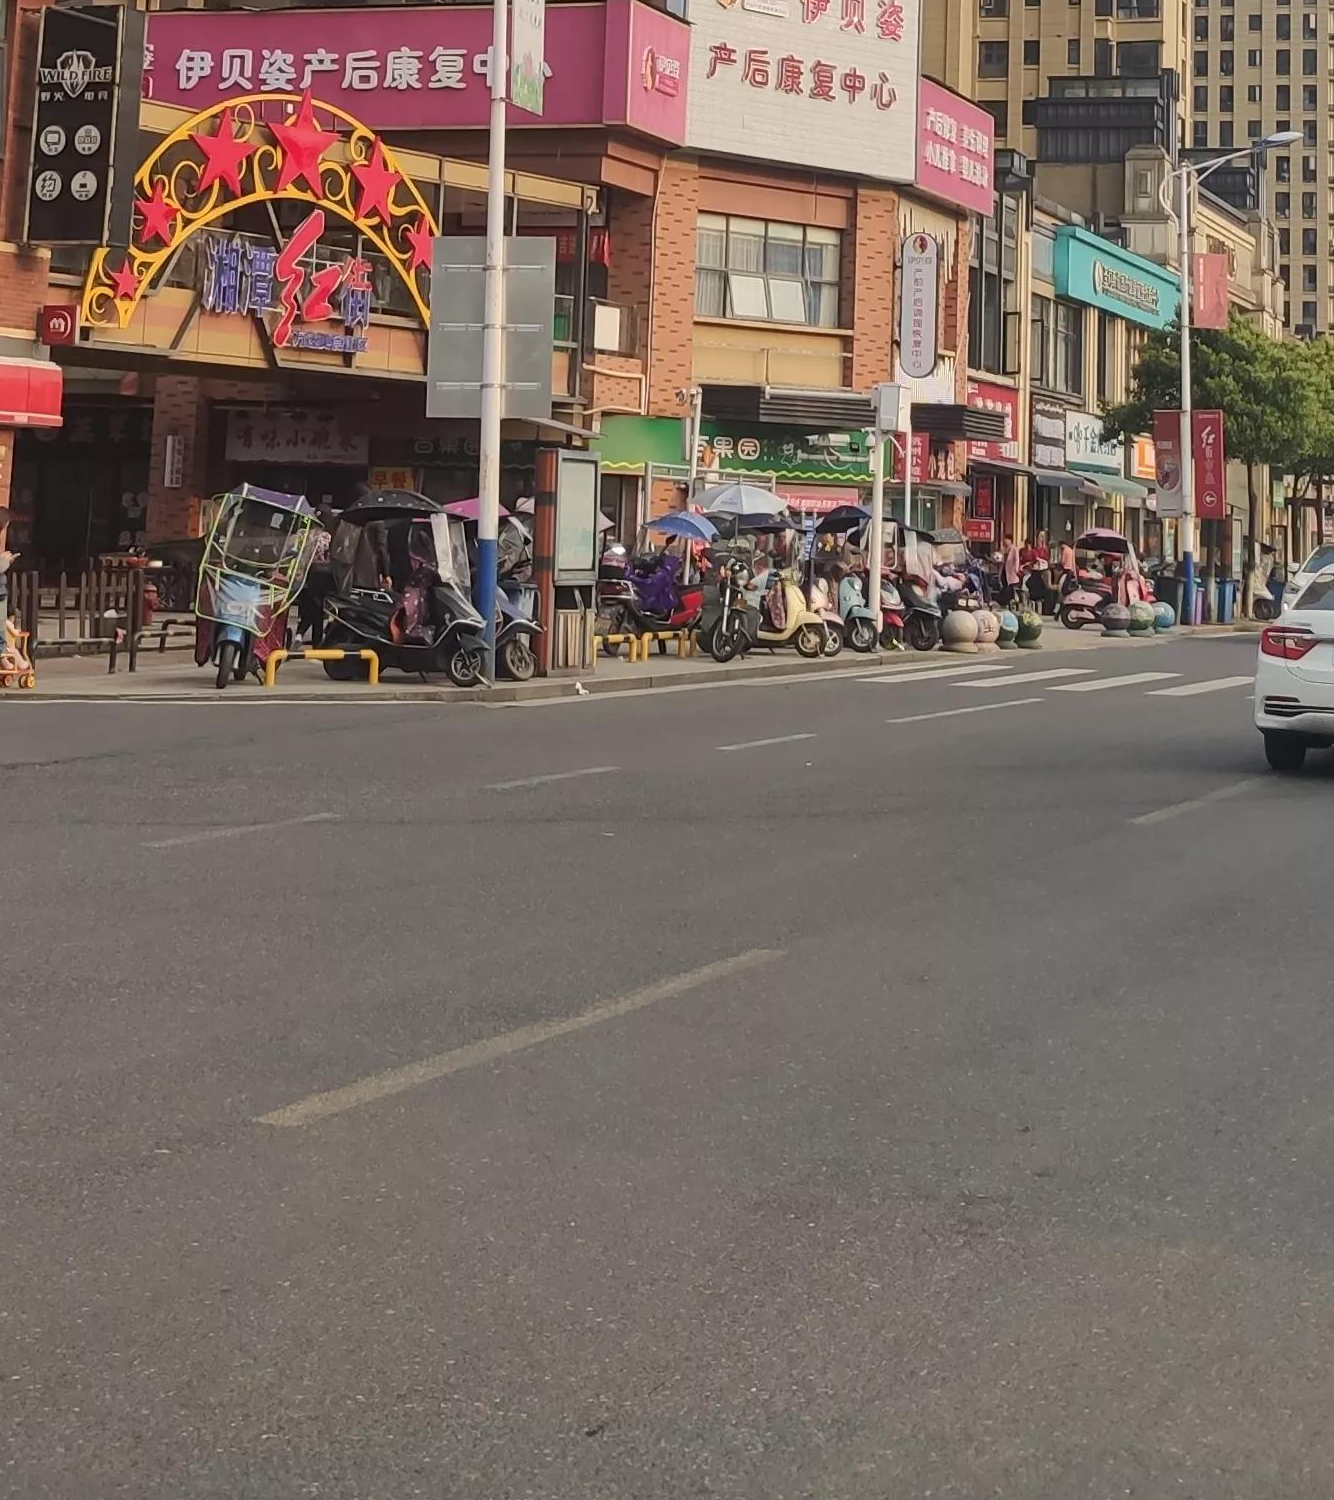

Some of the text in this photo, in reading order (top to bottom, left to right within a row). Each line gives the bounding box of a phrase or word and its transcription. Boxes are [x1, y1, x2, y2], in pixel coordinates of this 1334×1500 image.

[40, 66, 113, 84] WILD FIRE
[707, 42, 898, 111] 产后康复中心
